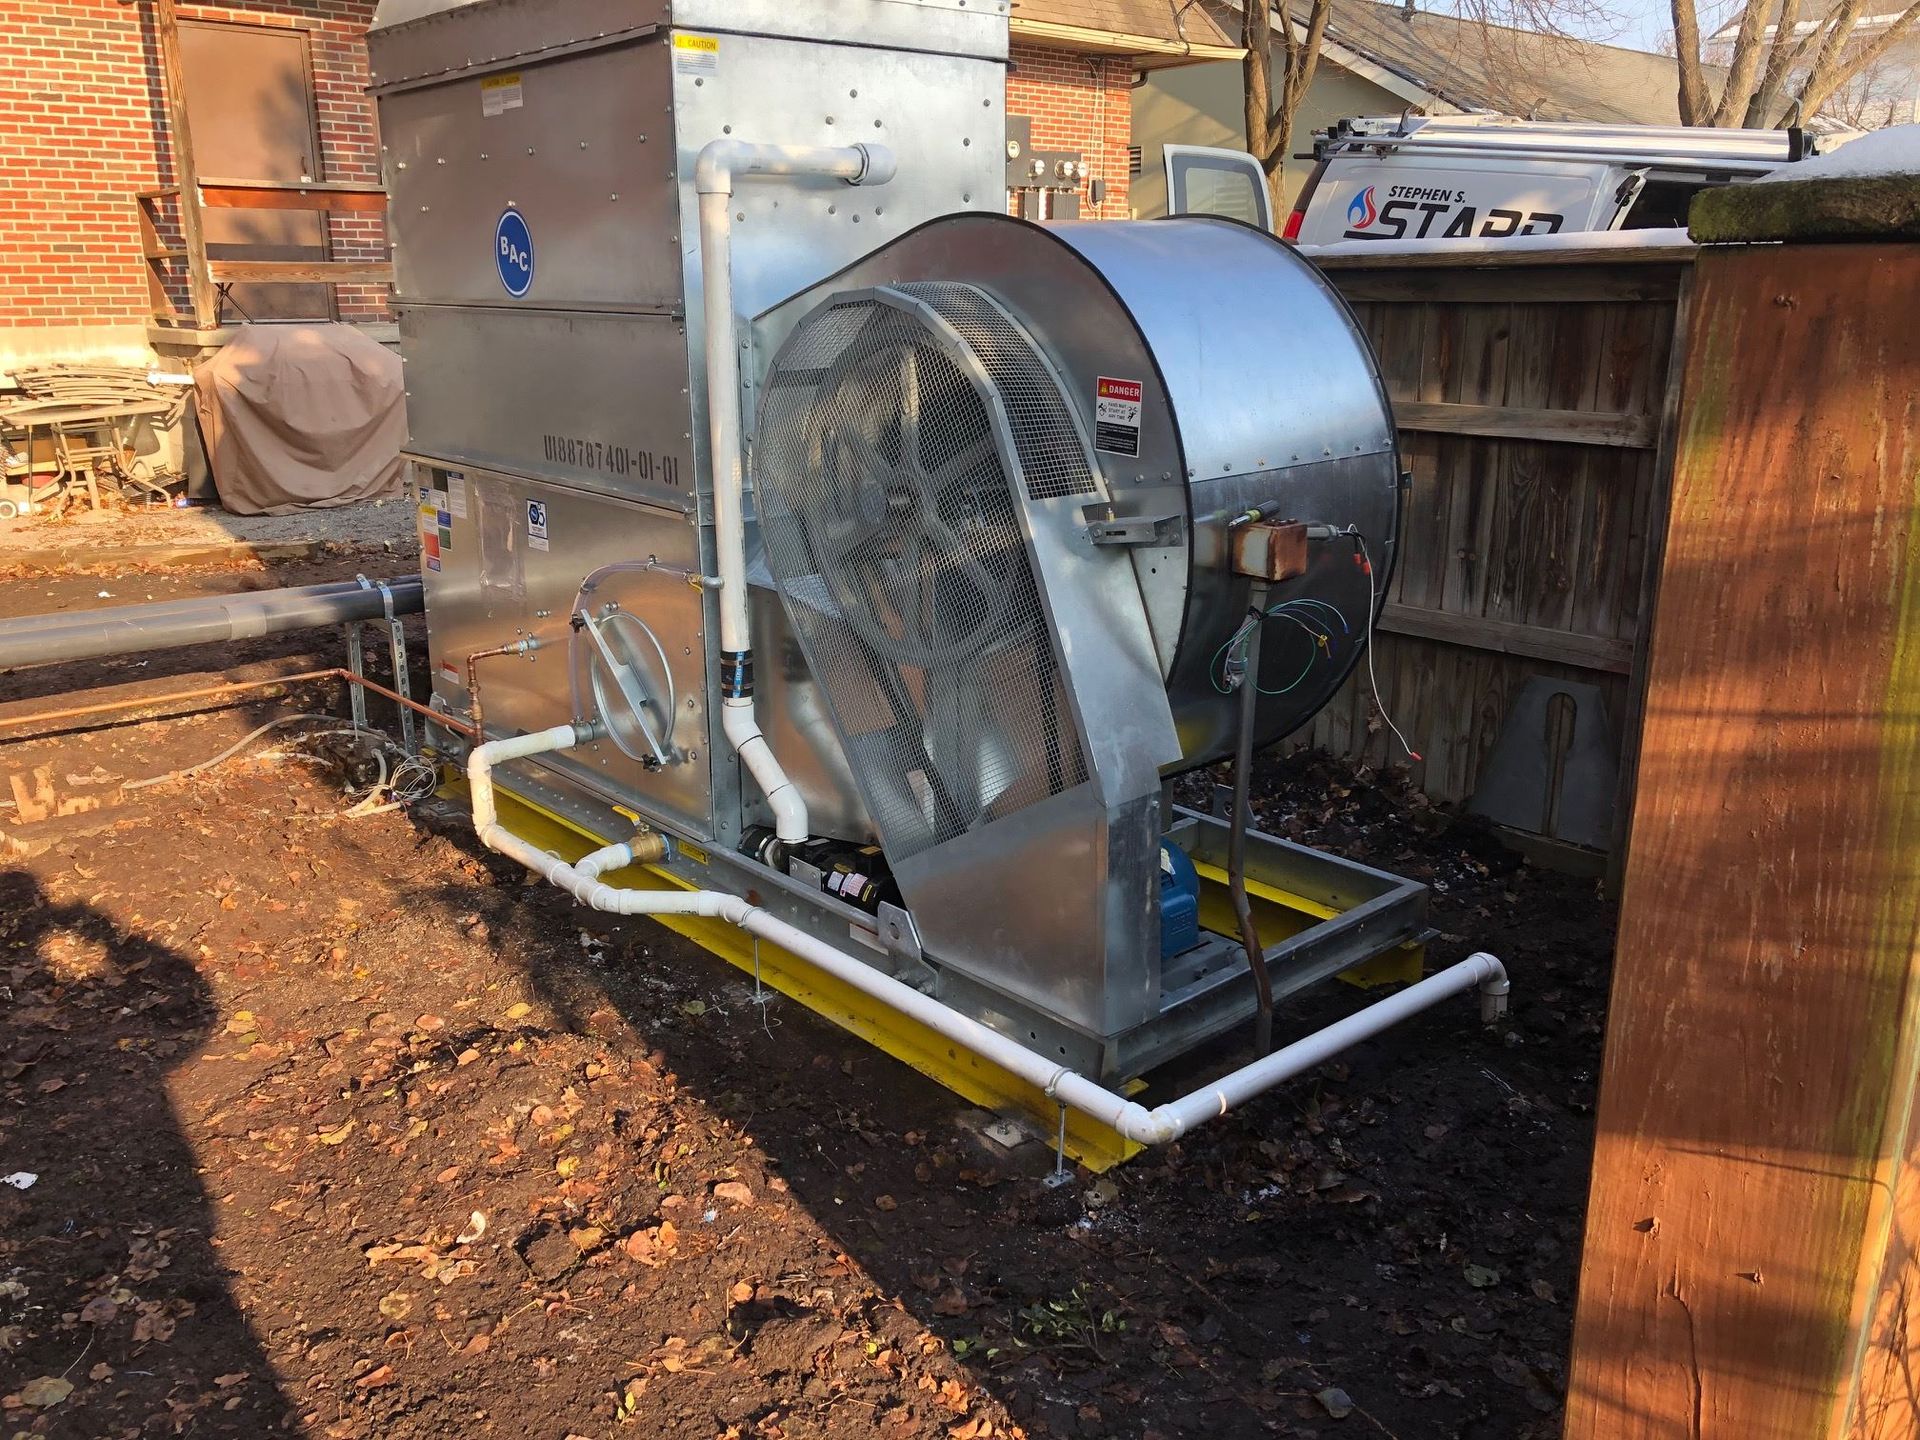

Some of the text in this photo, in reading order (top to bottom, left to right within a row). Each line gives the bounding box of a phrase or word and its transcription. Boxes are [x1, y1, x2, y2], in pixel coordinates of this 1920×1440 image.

[687, 38, 716, 50] CAUTION
[1388, 185, 1466, 203] STEPHEN S.
[500, 236, 529, 272] BAC
[1108, 385, 1140, 397] DANGER
